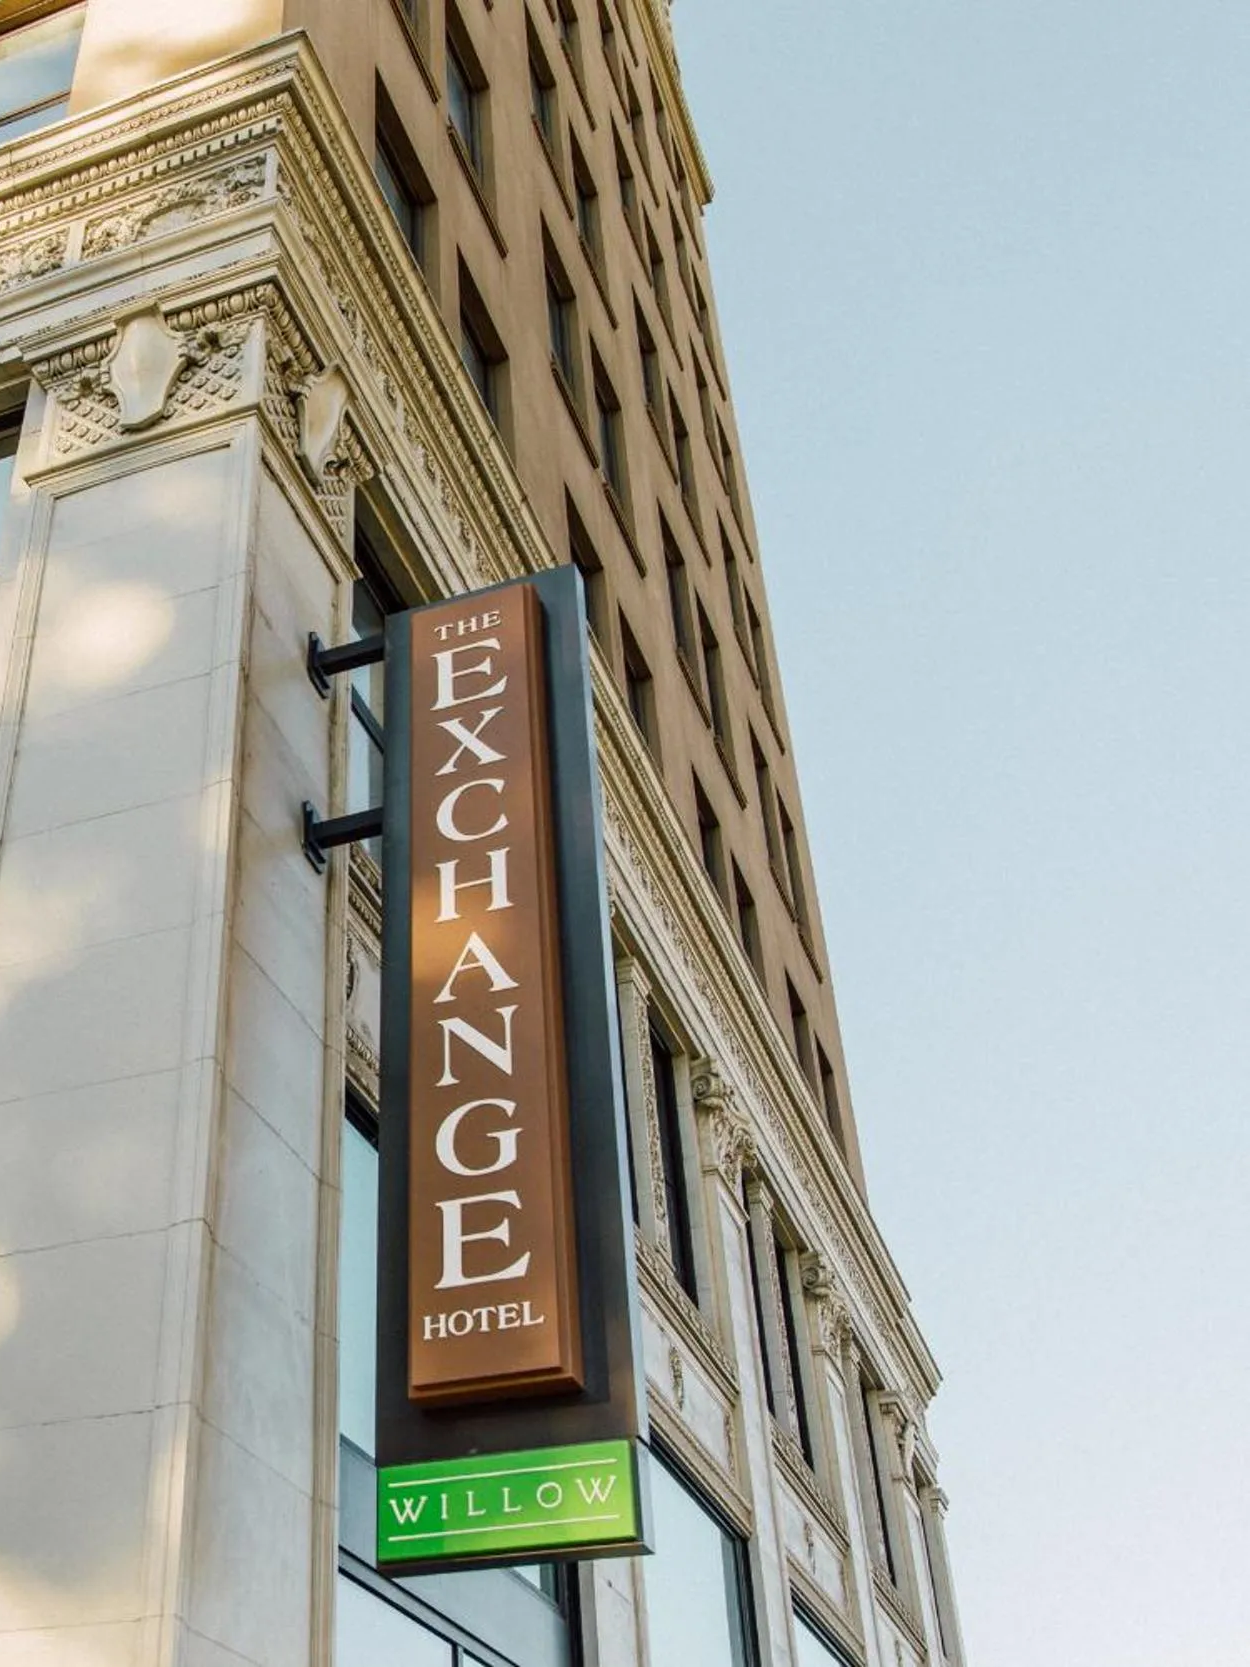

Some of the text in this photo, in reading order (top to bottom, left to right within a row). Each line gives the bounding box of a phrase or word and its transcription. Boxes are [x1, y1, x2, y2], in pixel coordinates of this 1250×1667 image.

[434, 609, 501, 641] THE
[430, 637, 531, 1289] EXCHANGE
[422, 1301, 544, 1341] HOTEL
[389, 1475, 617, 1525] WILLOW
